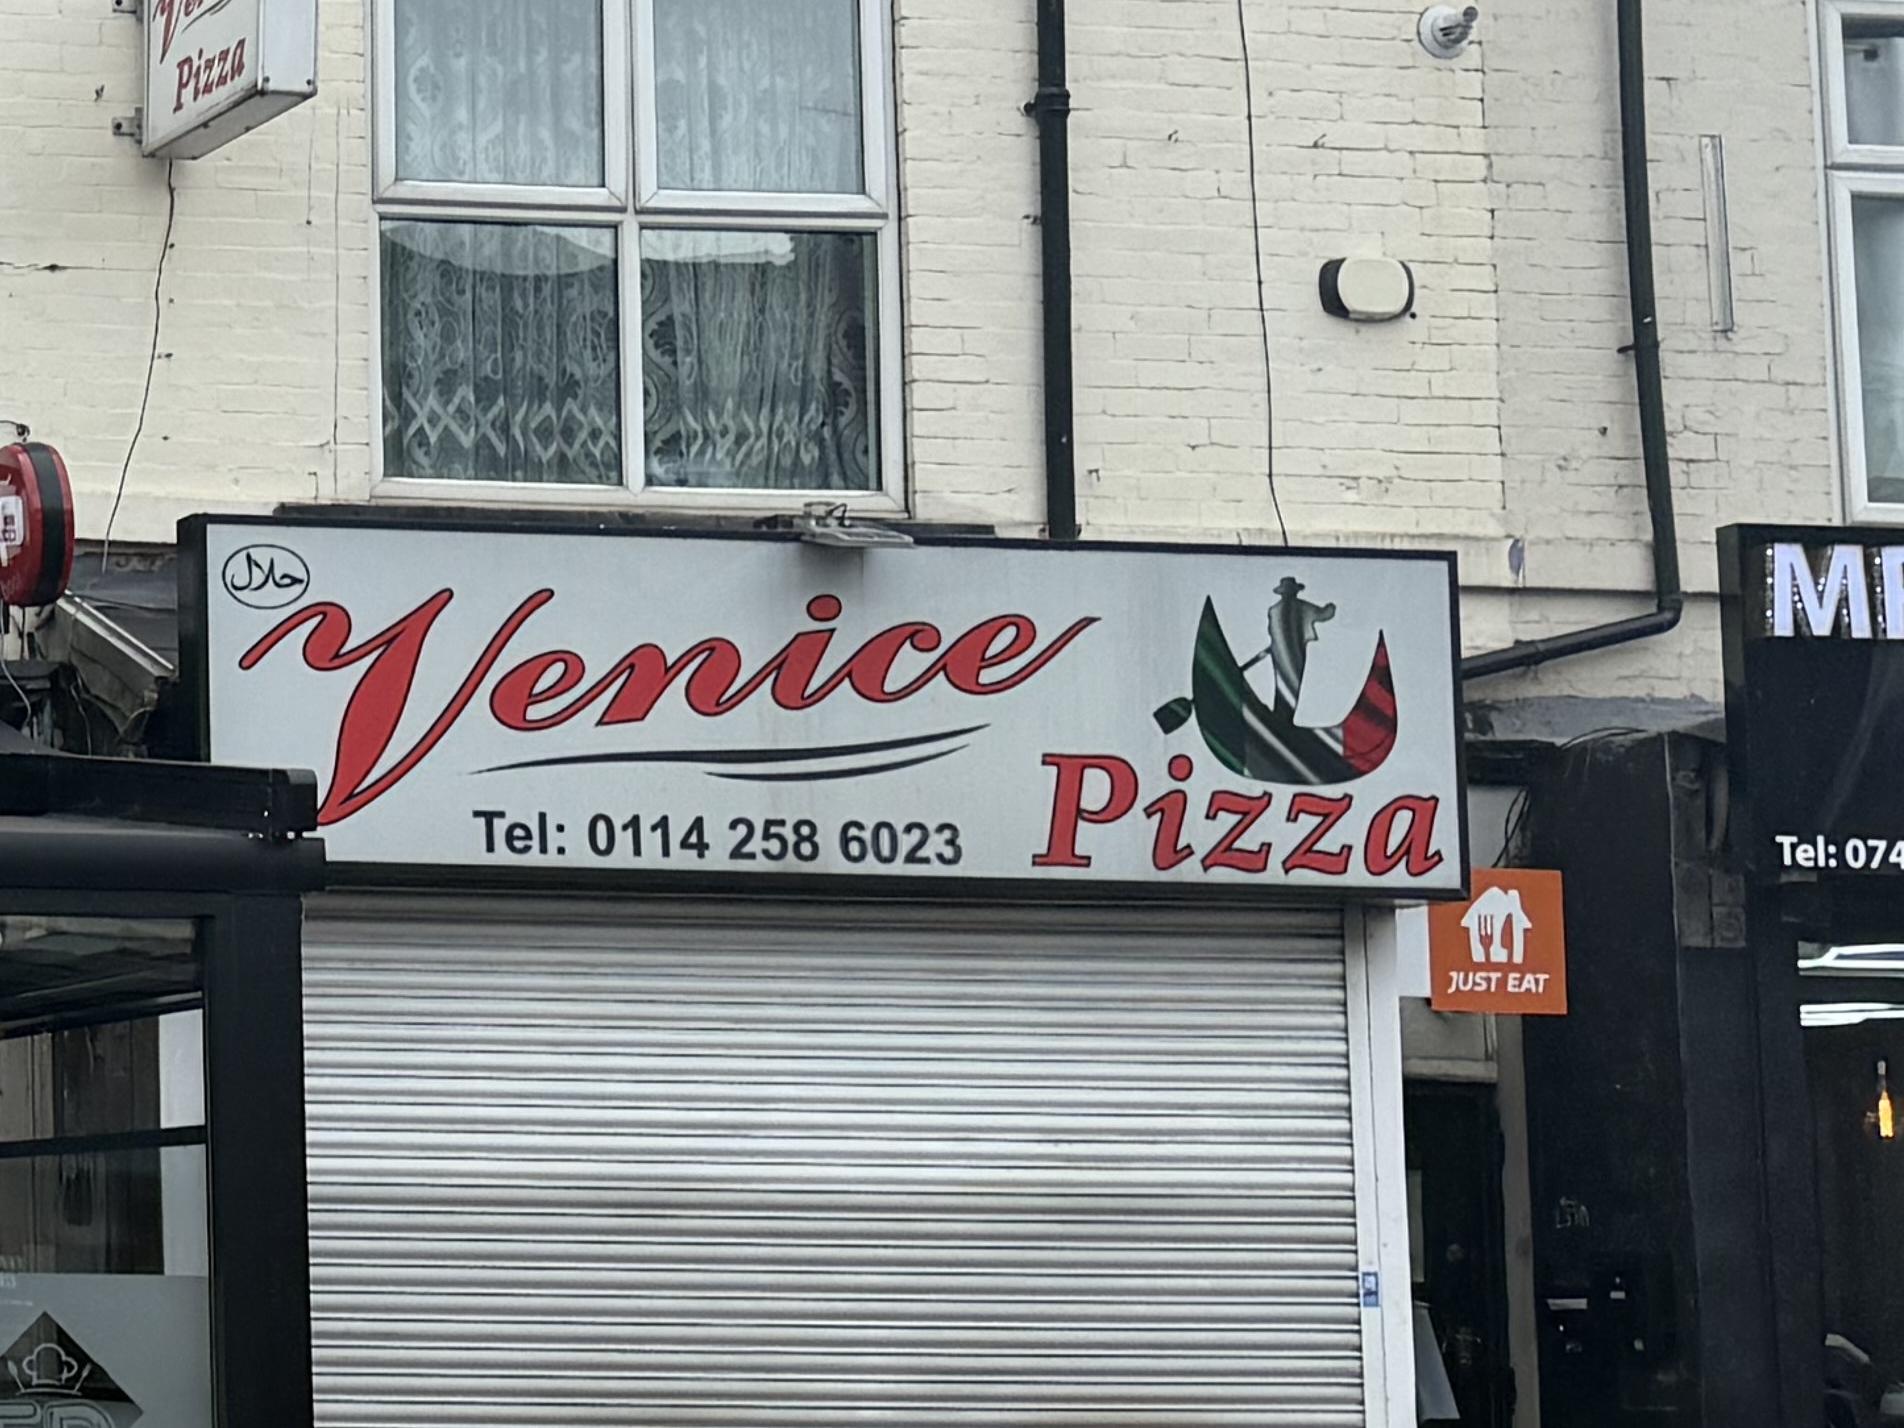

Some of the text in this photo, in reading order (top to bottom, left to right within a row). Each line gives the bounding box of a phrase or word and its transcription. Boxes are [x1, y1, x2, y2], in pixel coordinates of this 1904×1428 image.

[172, 37, 247, 115] Pizza
[238, 587, 1101, 826] Venice
[473, 811, 963, 866] Tel: 0114 258 6023
[1032, 753, 1443, 877] Pizza
[1775, 834, 1837, 868] Tel:
[1448, 971, 1549, 994] JUST EAT
